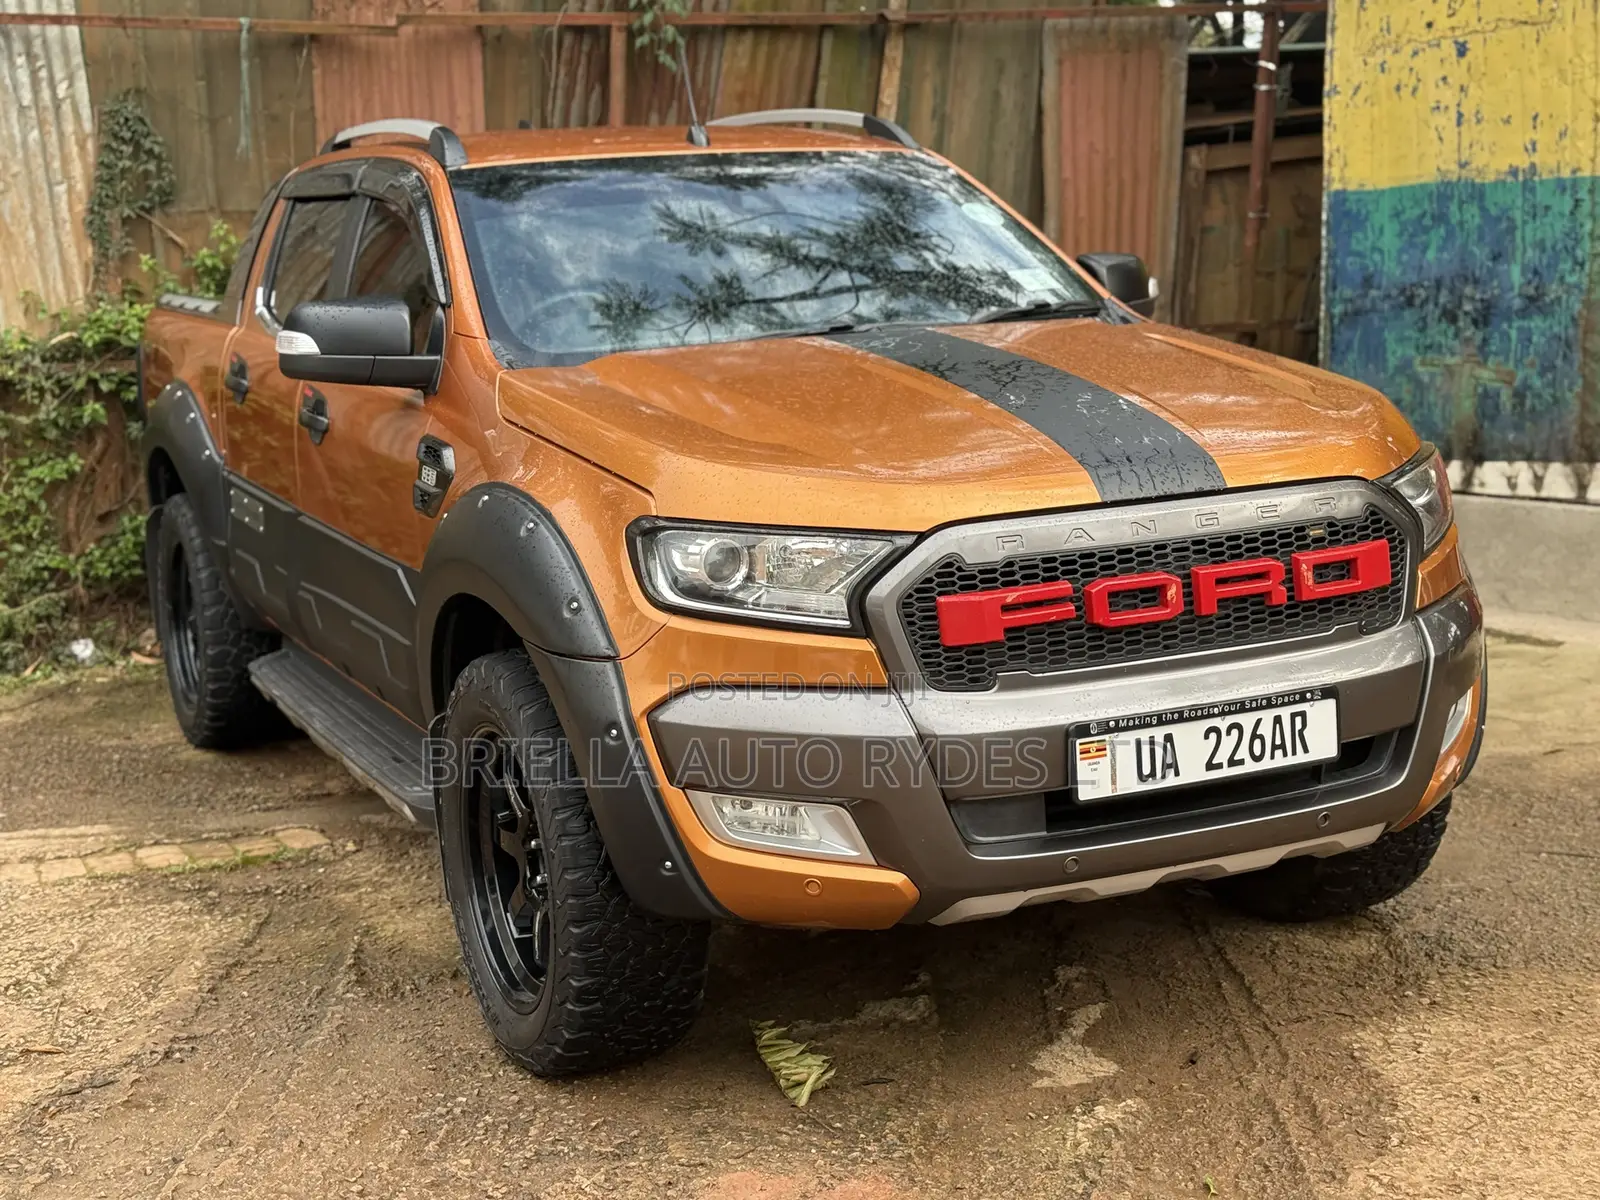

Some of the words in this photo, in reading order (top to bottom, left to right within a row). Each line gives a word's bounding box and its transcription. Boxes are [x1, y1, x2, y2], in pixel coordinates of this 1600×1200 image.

[996, 496, 1339, 553] RANGER
[936, 539, 1392, 647] FORD
[1118, 715, 1158, 728] Making
[1162, 711, 1179, 721] the
[1183, 706, 1214, 719] Roads
[1217, 703, 1241, 714] Your
[1245, 699, 1267, 709] Safe
[1271, 693, 1300, 706] Space
[1135, 732, 1180, 782] UA
[1203, 710, 1310, 772] 226AR
